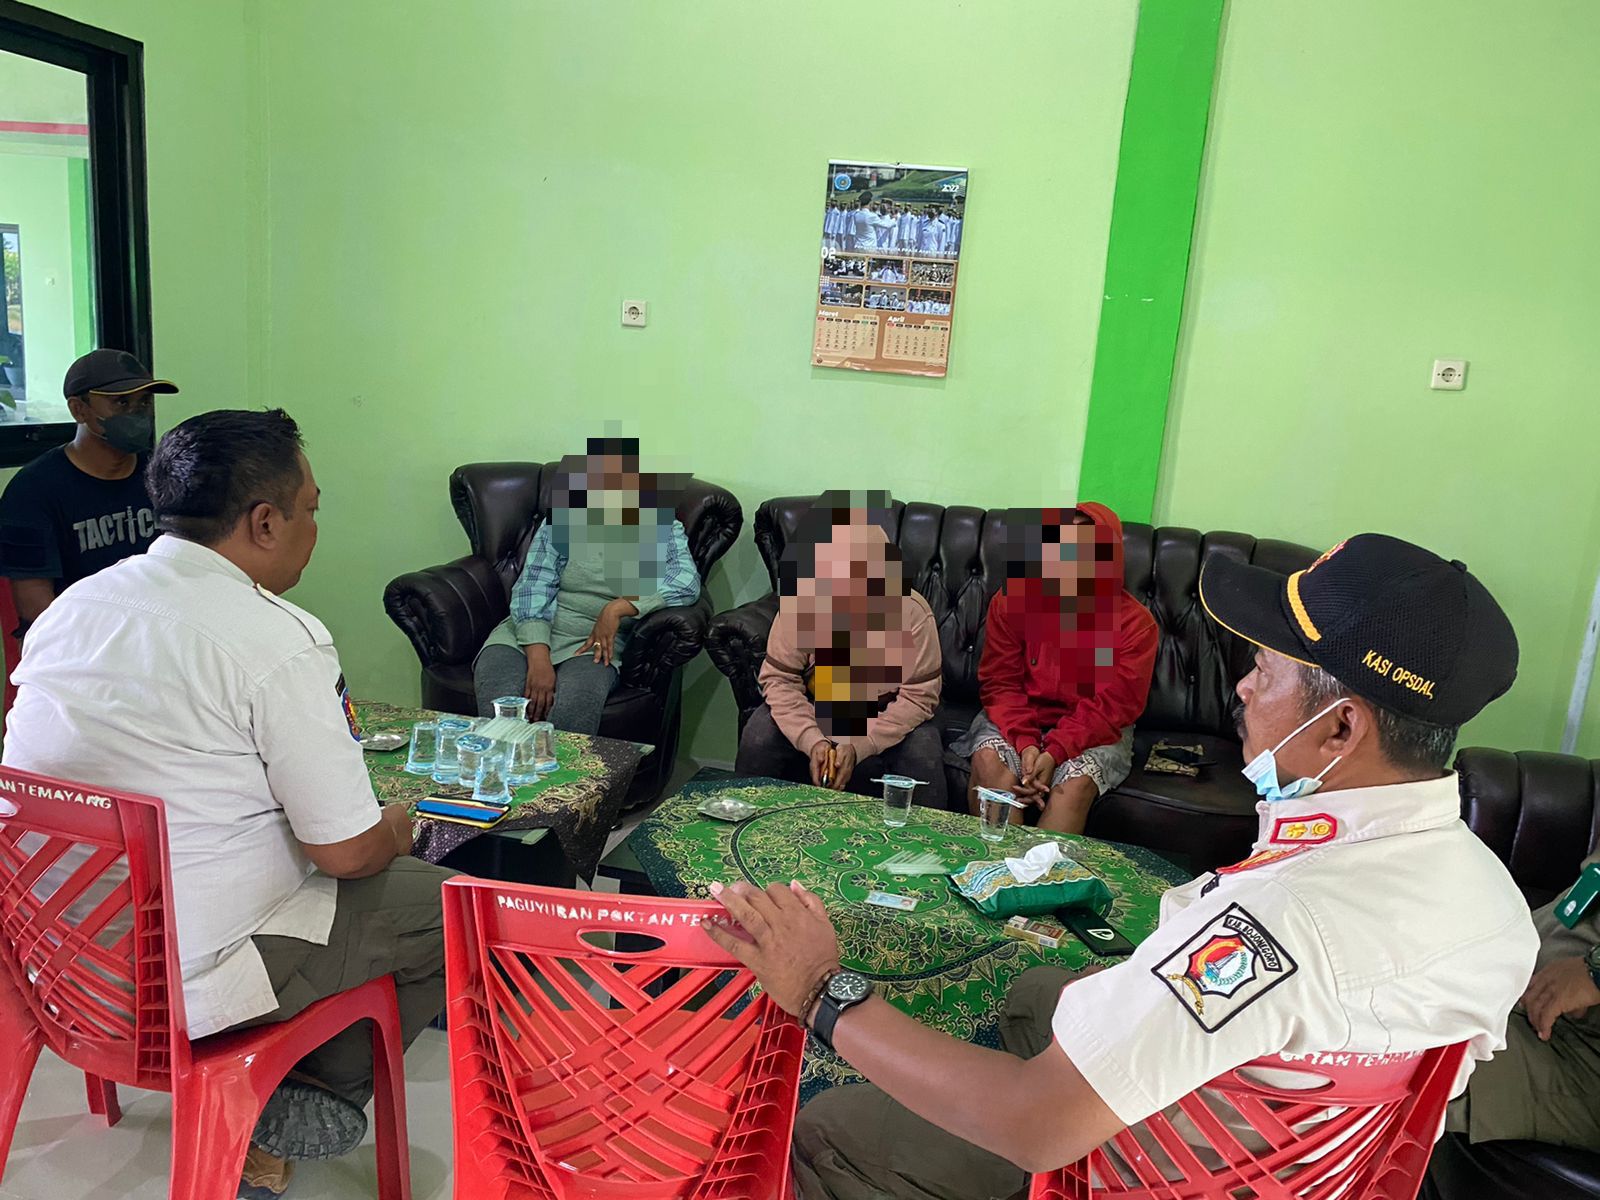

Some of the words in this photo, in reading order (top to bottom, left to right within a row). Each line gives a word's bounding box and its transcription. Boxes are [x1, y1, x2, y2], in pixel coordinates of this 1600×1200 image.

[887, 315, 906, 325] April
[1361, 649, 1394, 677] KASI
[1242, 925, 1278, 968] BOJONEGORO
